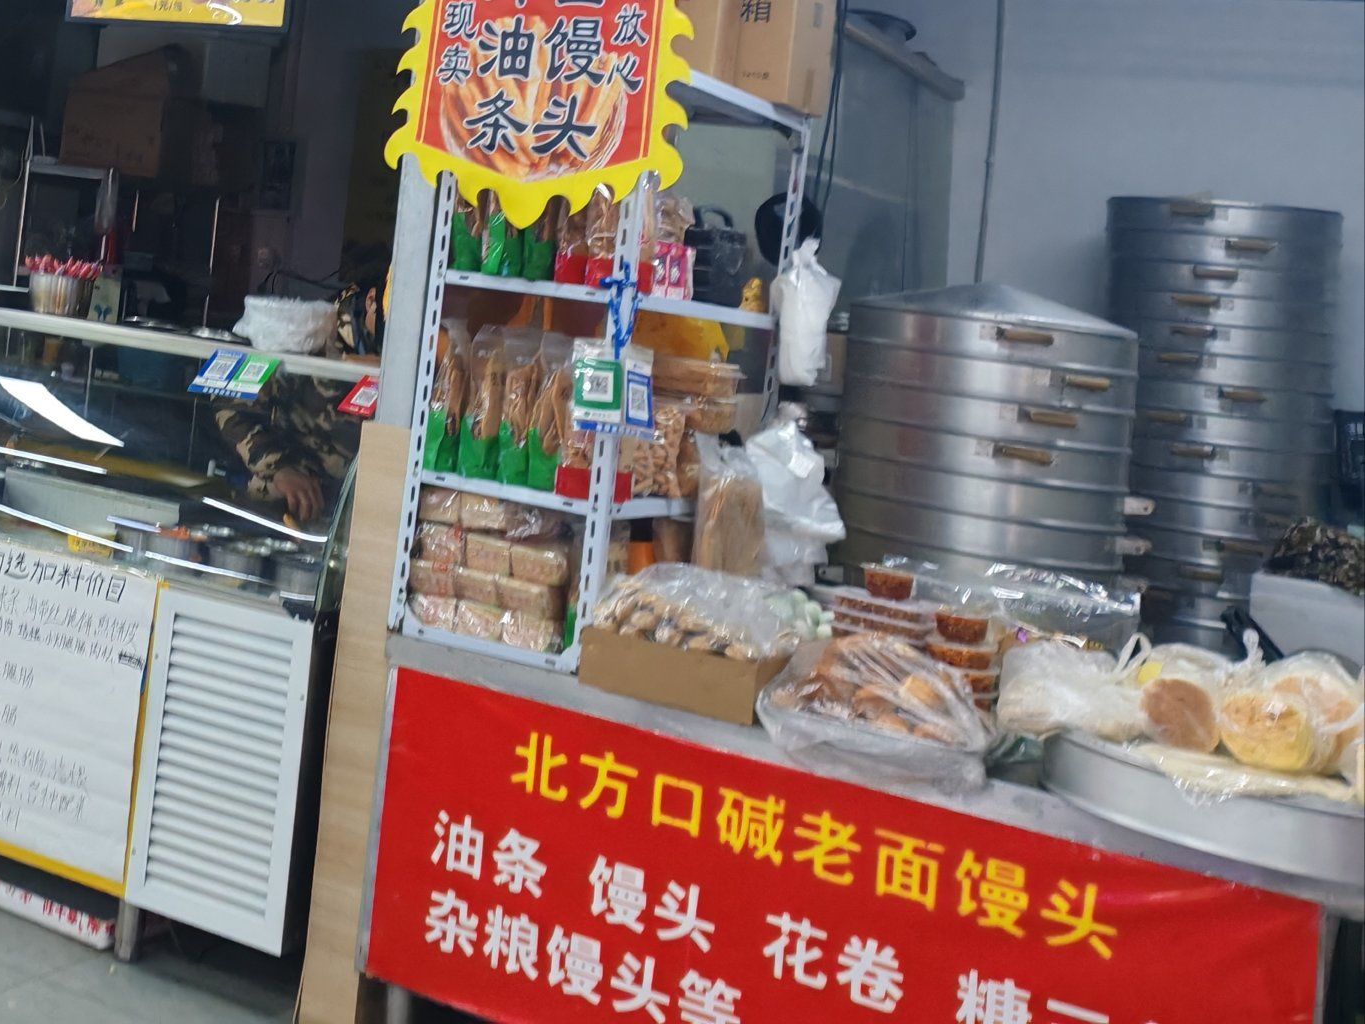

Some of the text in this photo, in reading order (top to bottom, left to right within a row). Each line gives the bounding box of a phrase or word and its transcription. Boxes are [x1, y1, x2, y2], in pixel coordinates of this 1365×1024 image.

[431, 810, 548, 898] 油条
[589, 854, 716, 954] 馒头
[763, 912, 904, 1014] 花卷
[510, 731, 1118, 960] 北方口碱老面馒头
[425, 888, 742, 1024] 杂粮馒头等
